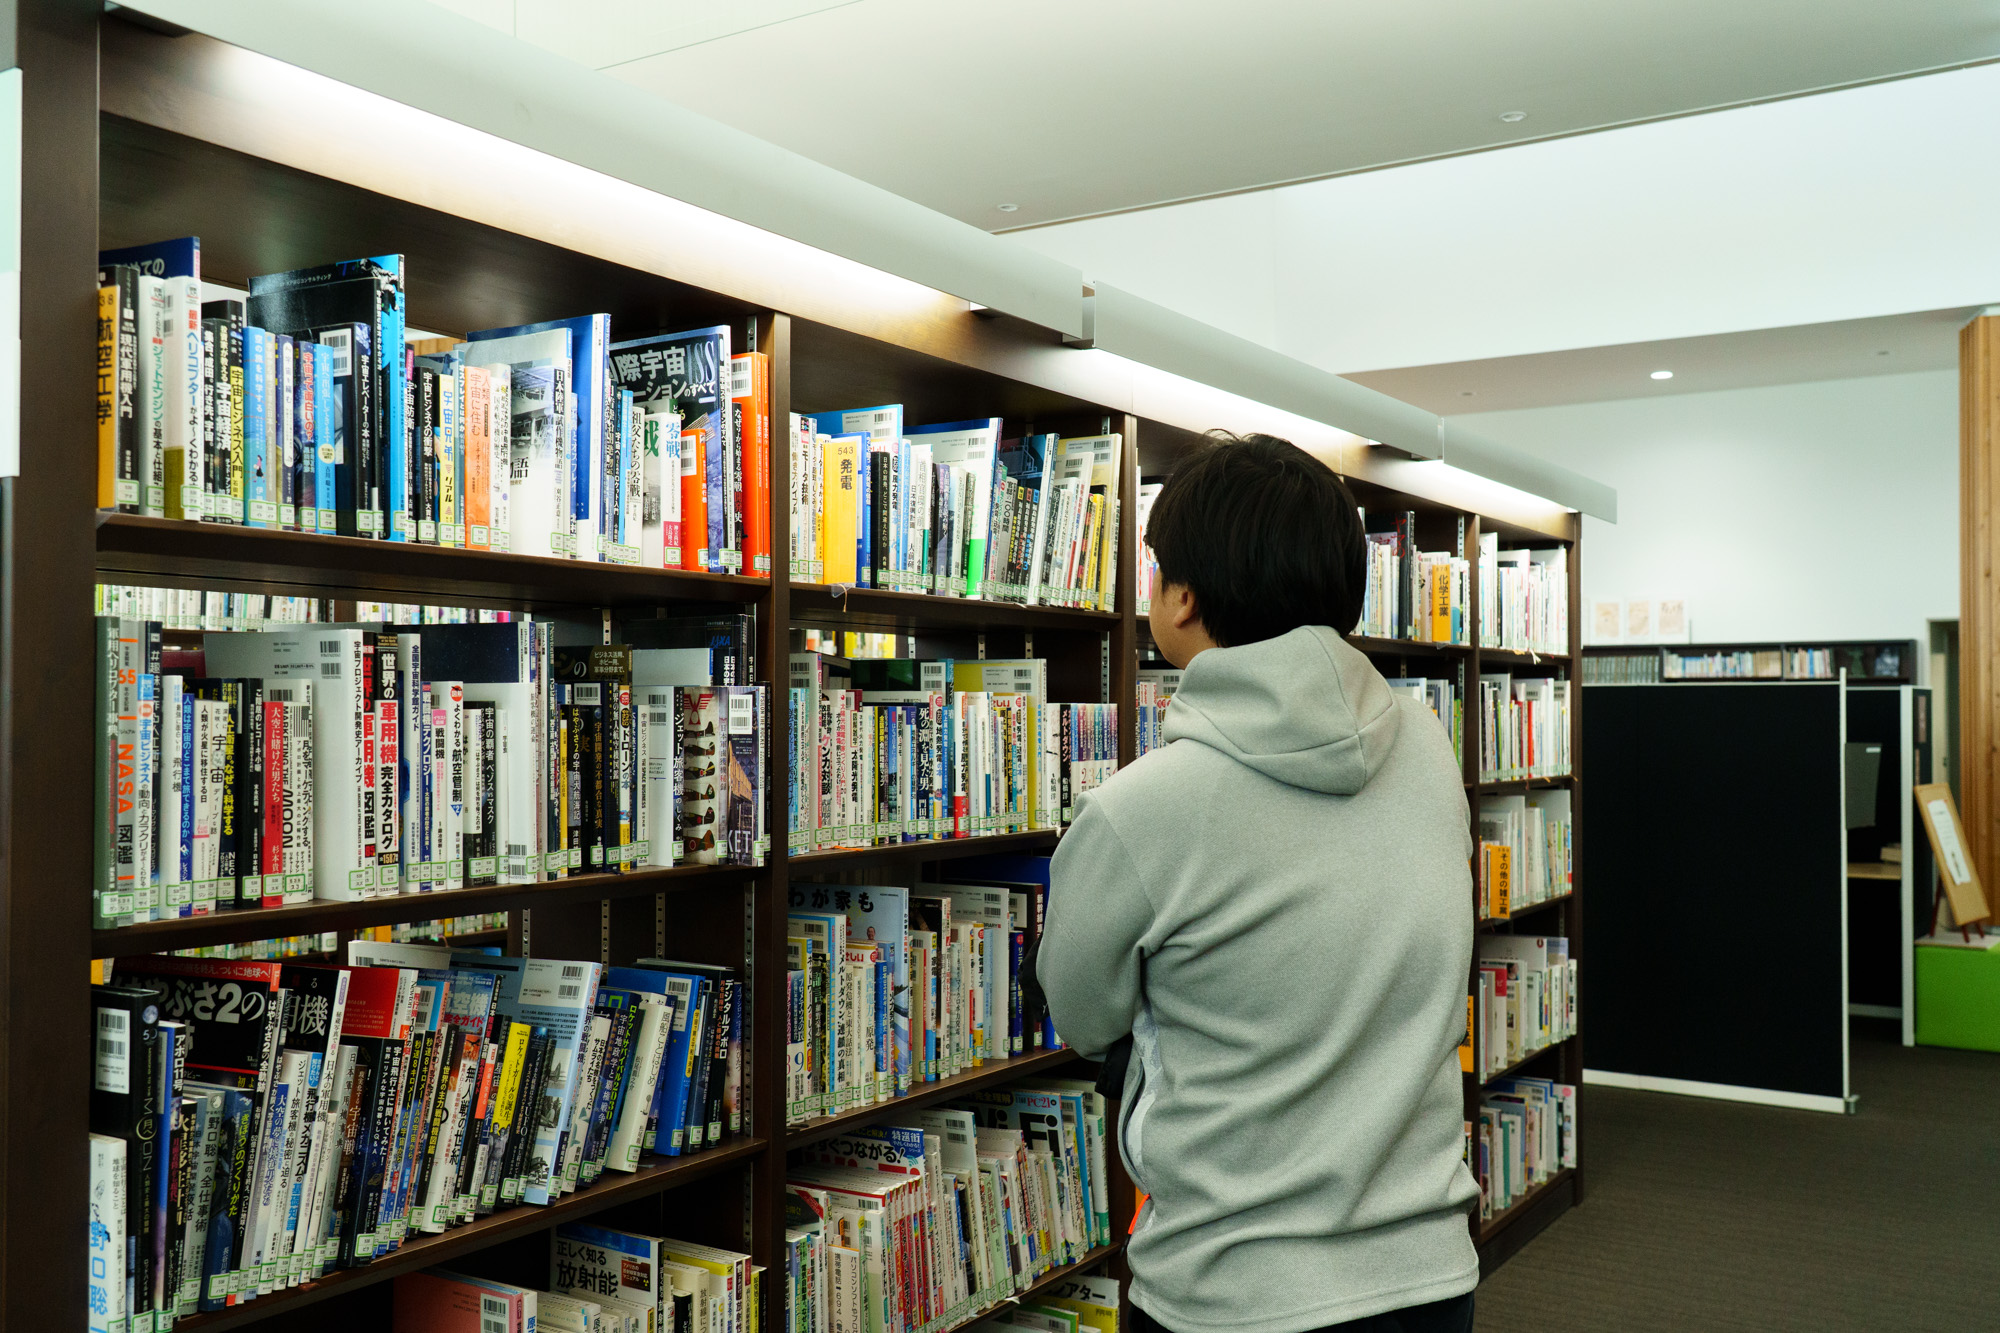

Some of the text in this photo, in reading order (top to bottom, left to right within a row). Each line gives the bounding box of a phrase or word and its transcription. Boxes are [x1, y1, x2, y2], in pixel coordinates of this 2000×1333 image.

[97, 316, 114, 425] 航空工学
[120, 333, 133, 418] 現代軍用機入門
[361, 354, 370, 438] 宇宙エレベーターの本
[686, 341, 716, 385] ISS
[231, 369, 243, 479] 宇宙ビジネス入門
[423, 372, 432, 457] 宇宙ビジネスの衝撃
[443, 391, 453, 502] 宇宙兄弟 リアル
[630, 412, 641, 497] 祖父たちの零戦
[666, 422, 681, 459] 零戦
[838, 446, 854, 456] 543
[840, 458, 852, 490] 発電
[1438, 575, 1449, 617] 化学工業
[354, 641, 362, 783] 宇宙プロジェクト開発史アーカイブ
[411, 645, 420, 732] 全国宇宙科学館ガイド
[182, 695, 192, 838] 人類は宇宙のどこまで旅できるのか
[200, 705, 208, 803] 人類が火星に移住する日
[271, 707, 281, 803] 大空に賭けた男たち
[380, 653, 397, 850] 世界の 軍用機 完全カタログ
[450, 704, 462, 803] よくわかる航空管制
[485, 707, 495, 761] 宇宙の覇者
[622, 732, 631, 790] ドローンの本
[673, 713, 684, 831] ジェット旅客機のしくみ
[919, 708, 930, 792] 死の淵を見た男
[118, 744, 135, 814] NASA
[173, 757, 181, 792] 飛行機
[118, 824, 133, 865] 図鑑
[283, 790, 294, 849] MOON
[228, 852, 236, 876] NEC
[1499, 853, 1508, 915] その他の雑工業
[719, 979, 734, 1059] デジタルアポロ
[174, 1034, 187, 1091] アポロ11号
[606, 1005, 637, 1120] ロケットサバイバル2030
[794, 1052, 805, 1073] 9
[195, 1116, 220, 1232] 野口聡一の全仕事術
[892, 1130, 920, 1143] 特選街
[556, 1260, 619, 1298] 放射能
[557, 1241, 607, 1265] 正しく知る
